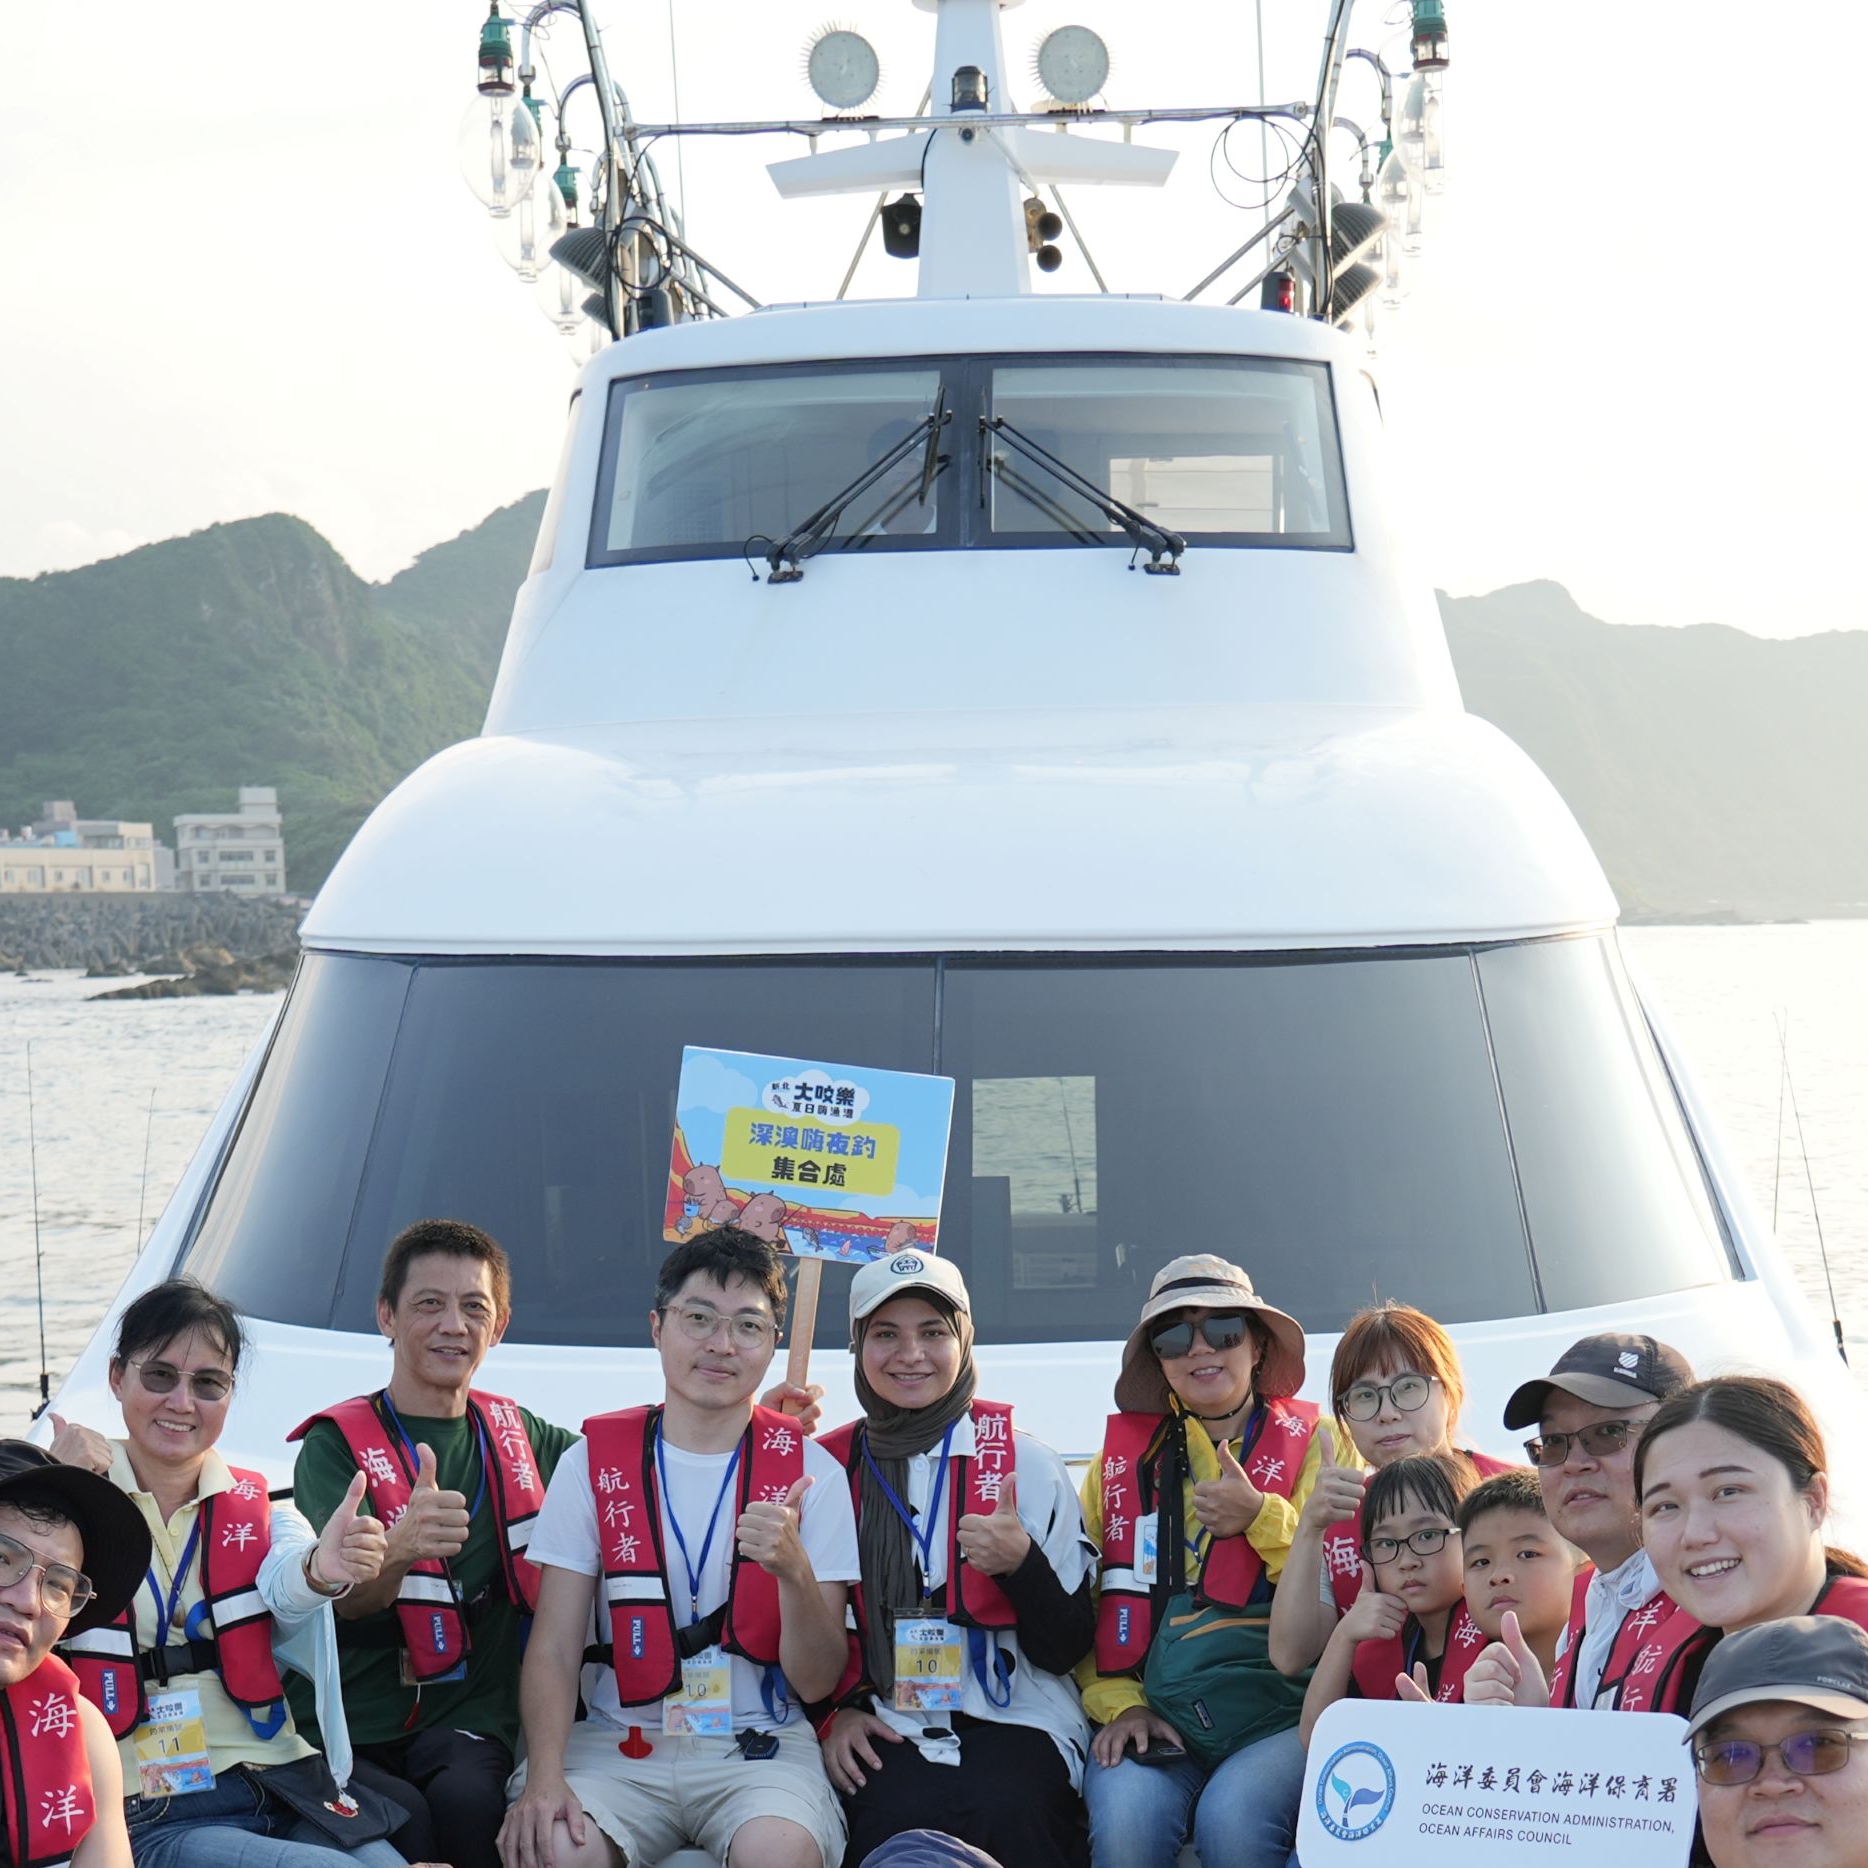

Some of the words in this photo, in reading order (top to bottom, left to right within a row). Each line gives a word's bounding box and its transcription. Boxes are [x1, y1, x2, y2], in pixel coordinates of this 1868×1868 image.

[794, 1082, 856, 1107] 大咬樂
[748, 1121, 876, 1160] 深澳嗨夜釣
[770, 1156, 847, 1187] 集合處
[489, 1400, 537, 1493] 航行者
[974, 1412, 1008, 1503] 航行者
[1250, 1411, 1307, 1487] 海洋
[597, 1467, 641, 1565] 航行者
[1102, 1455, 1129, 1543] 航行者
[632, 1618, 643, 1646] PULL
[1118, 1608, 1129, 1635] PULL
[104, 1672, 116, 1699] PULL
[29, 1692, 85, 1836] 海洋
[1426, 1762, 1679, 1804] 海洋委員會海洋保育署
[1419, 1822, 1461, 1837] OCEAN
[1463, 1824, 1514, 1841] AFFAIRS
[1517, 1830, 1572, 1846] COUNCIL
[1422, 1803, 1464, 1818] OCEAN
[1467, 1805, 1560, 1824] CONSERVATION
[1564, 1813, 1675, 1834] ADMINISTRATION,
